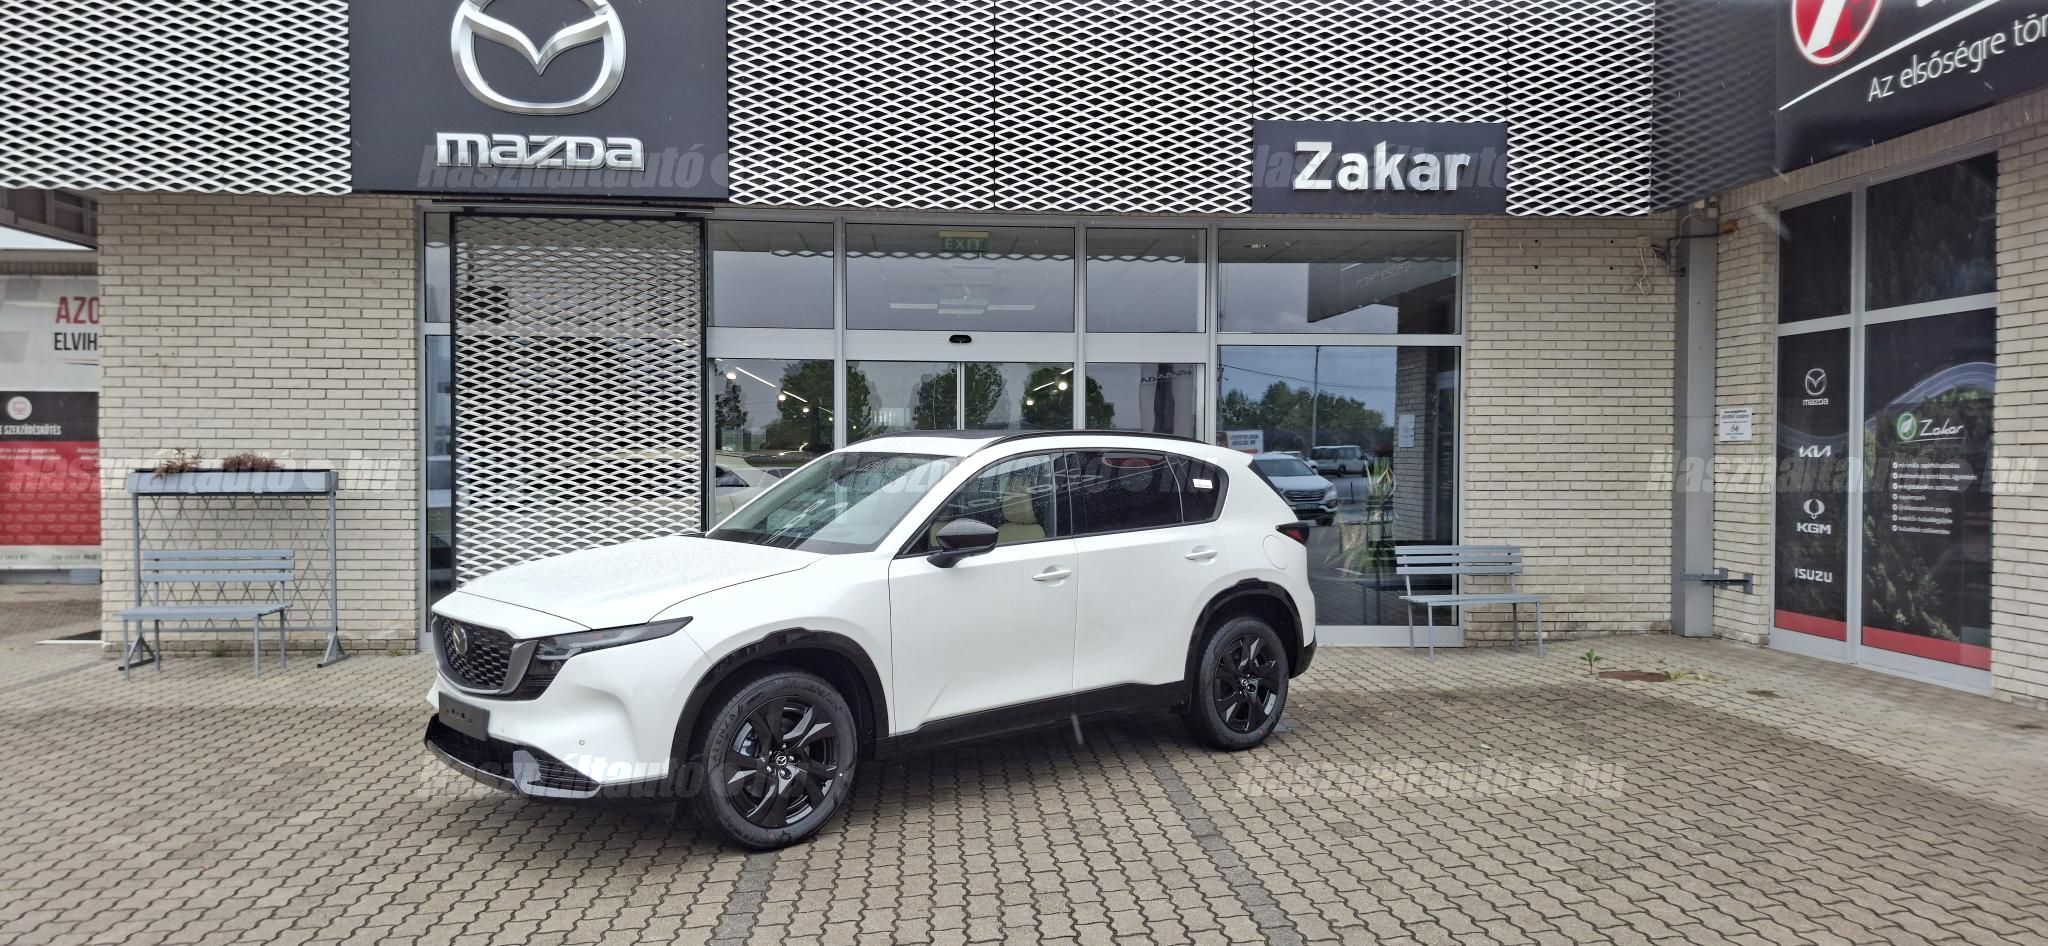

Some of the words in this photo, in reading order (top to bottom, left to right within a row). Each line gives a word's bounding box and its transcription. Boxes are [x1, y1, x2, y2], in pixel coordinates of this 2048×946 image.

[1868, 76, 1895, 102] Az
[1900, 33, 2006, 89] elsőségre
[1293, 140, 1471, 191] Zakar
[944, 238, 983, 250] EXIT
[54, 332, 97, 351] ELVIH
[1919, 418, 1964, 436] Zakar
[1796, 522, 1832, 535] KGM
[1794, 567, 1833, 583] ISUZU
